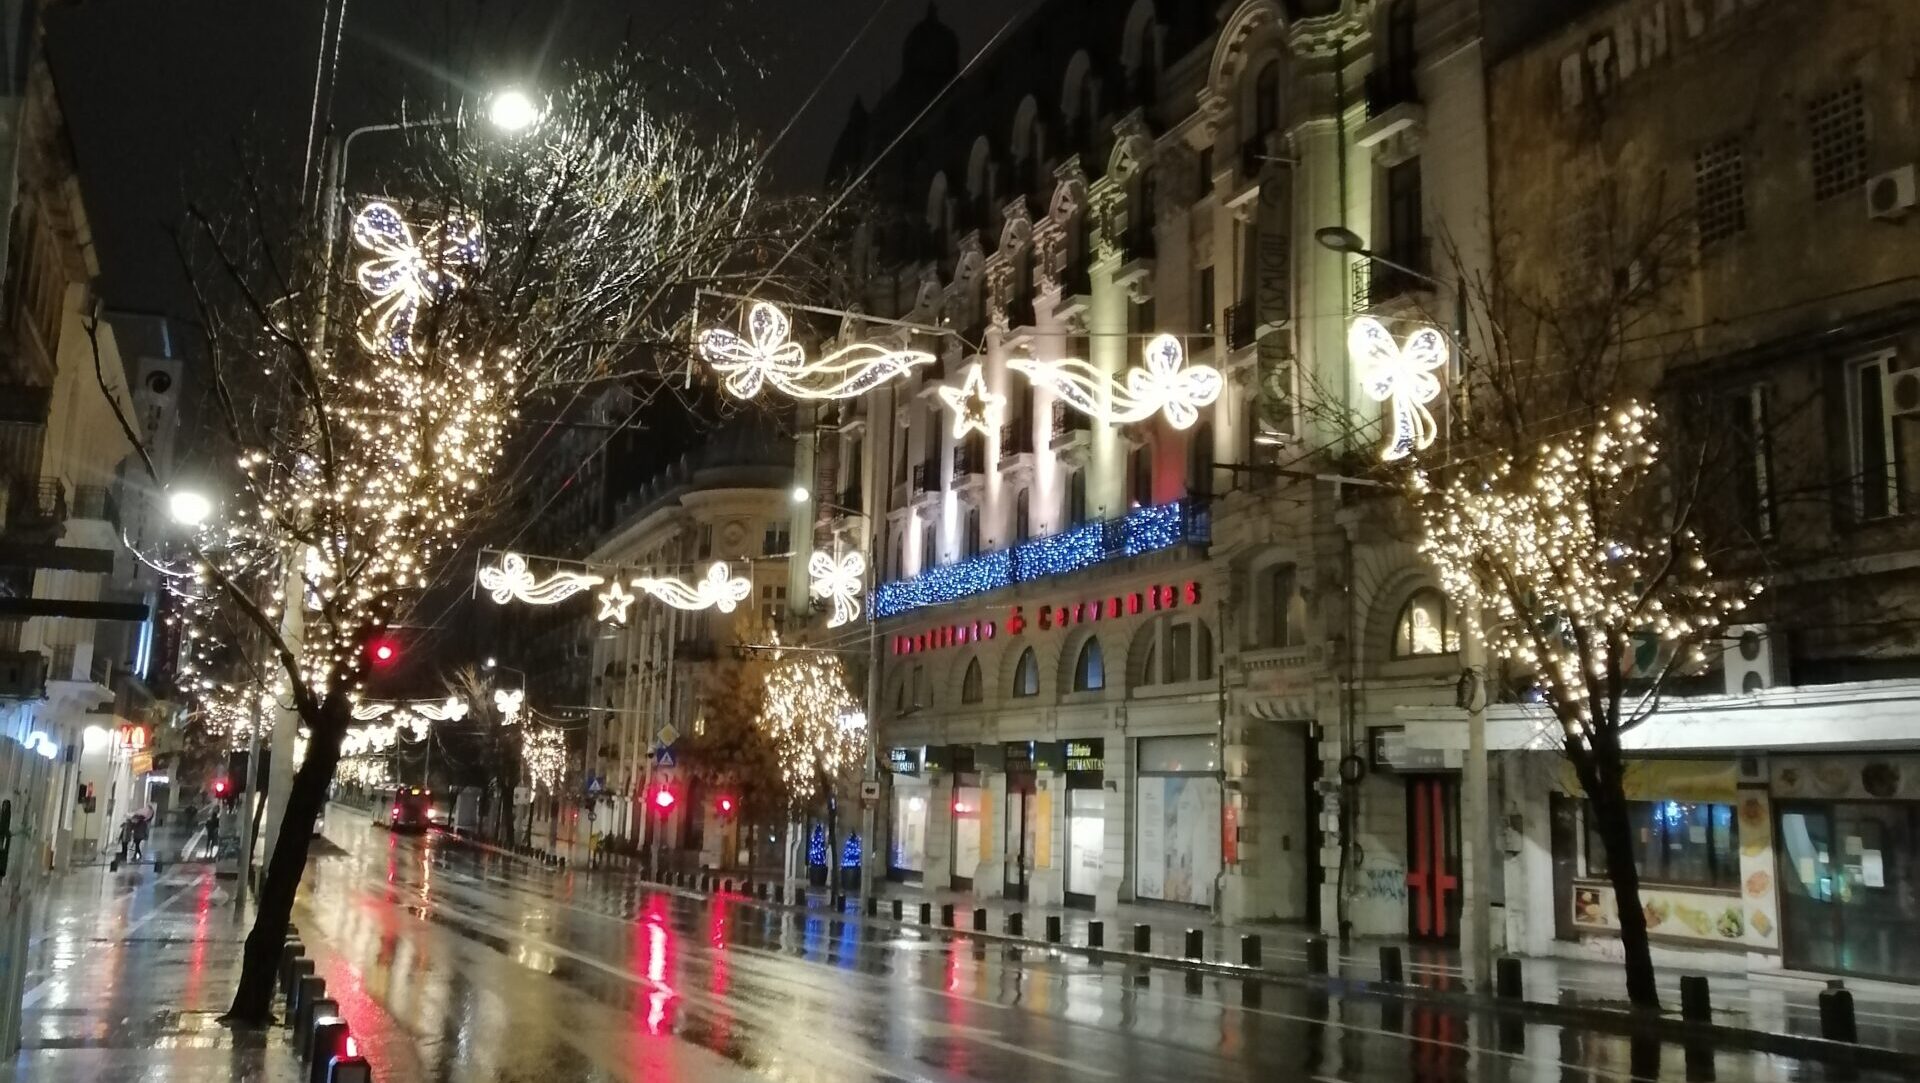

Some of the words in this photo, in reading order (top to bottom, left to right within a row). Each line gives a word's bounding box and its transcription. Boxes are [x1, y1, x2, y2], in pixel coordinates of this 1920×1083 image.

[892, 620, 997, 655] Instituto
[1038, 580, 1200, 630] Cervantes
[1067, 758, 1105, 771] HUMANITAS
